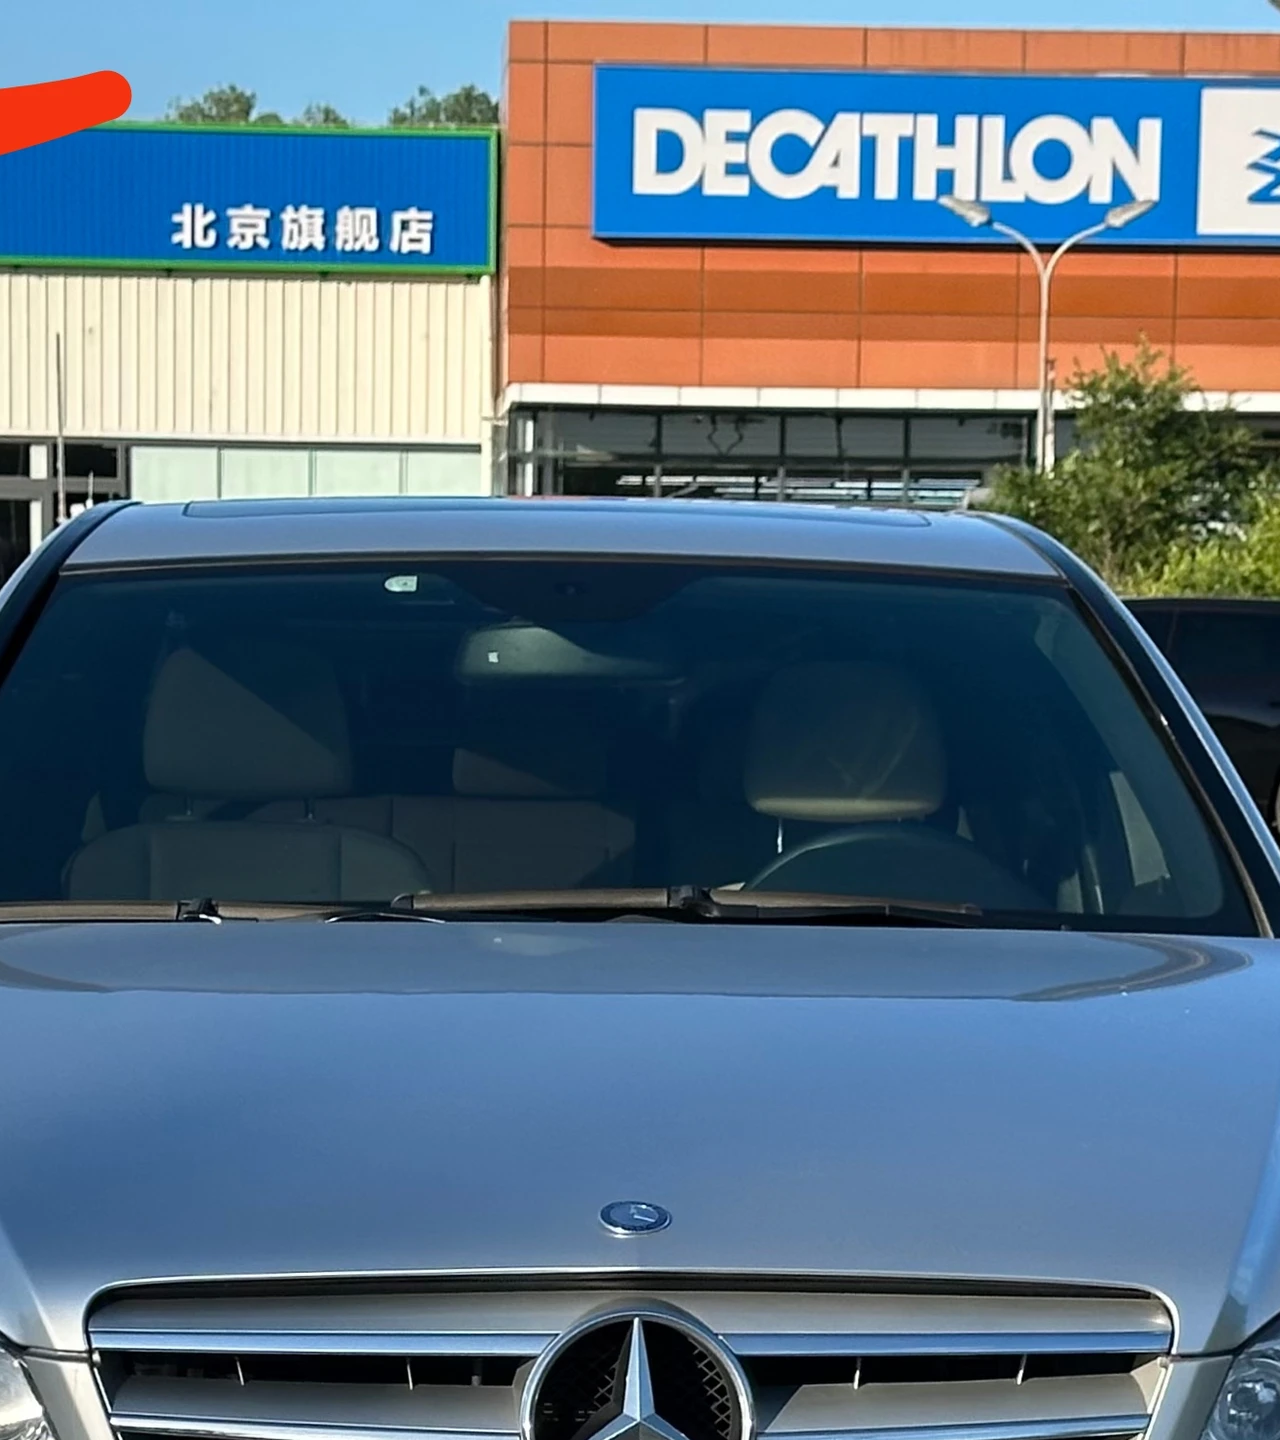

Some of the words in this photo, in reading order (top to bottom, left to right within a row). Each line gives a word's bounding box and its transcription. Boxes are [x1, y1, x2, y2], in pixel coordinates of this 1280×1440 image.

[632, 107, 1163, 205] DECATHLON
[170, 203, 434, 254] 北京旗舰店
